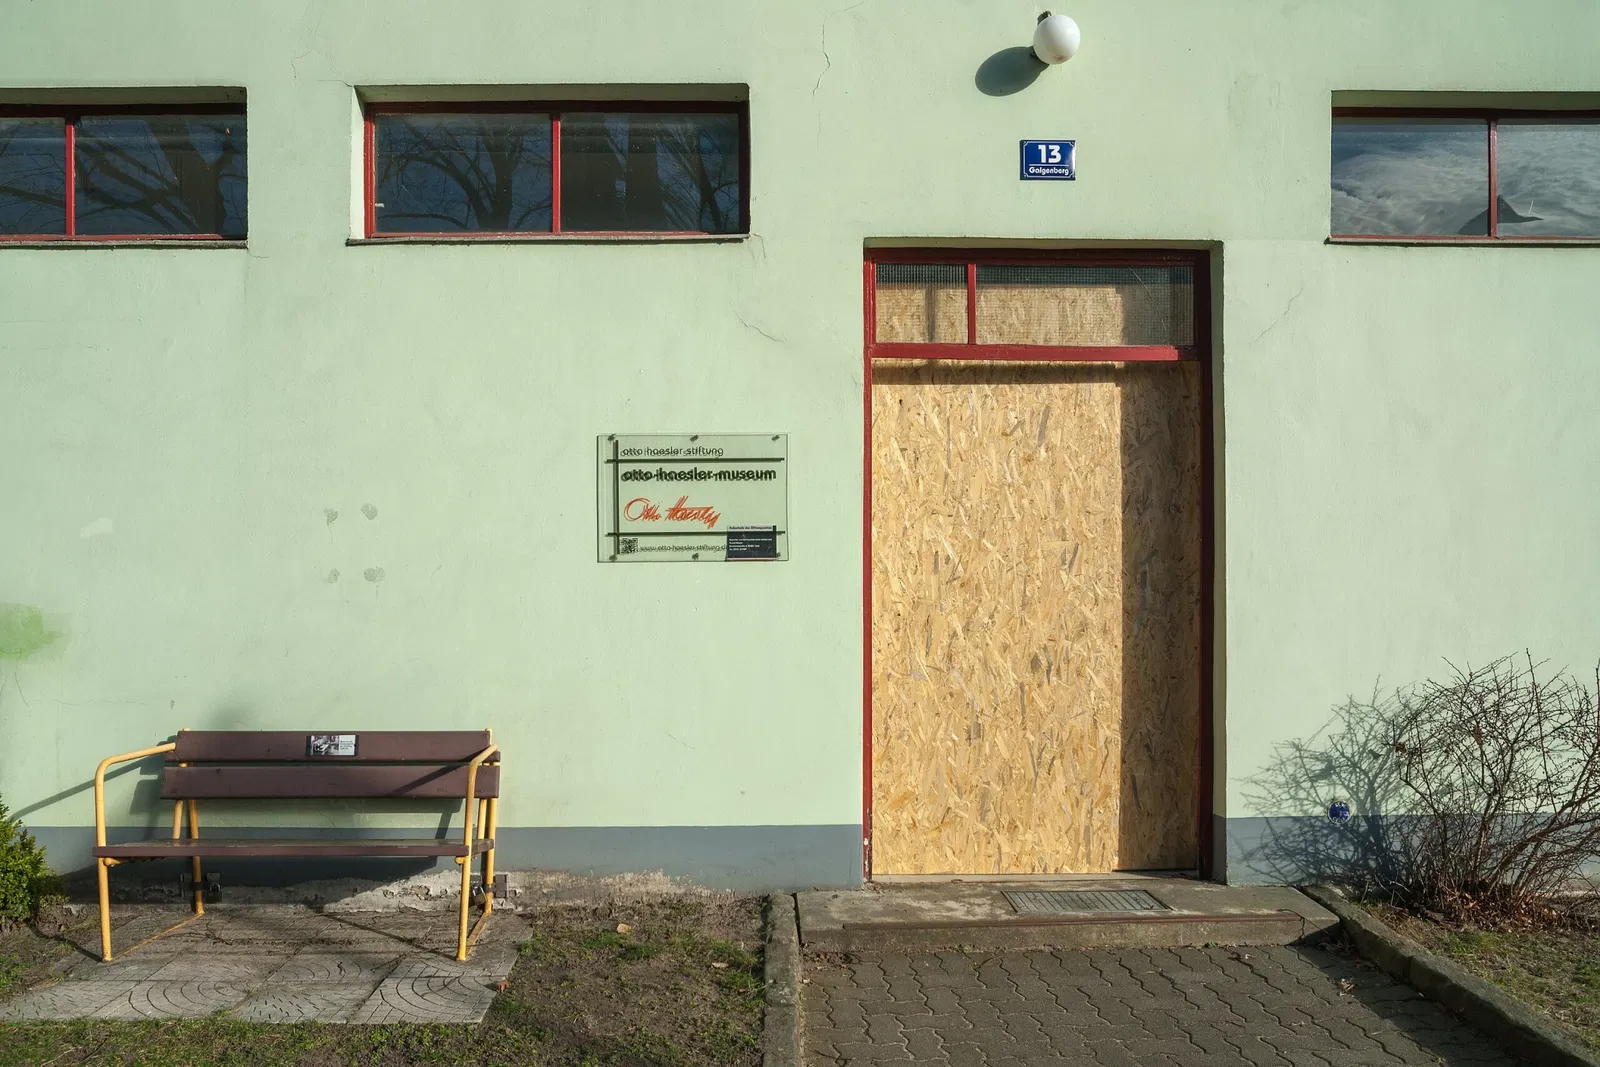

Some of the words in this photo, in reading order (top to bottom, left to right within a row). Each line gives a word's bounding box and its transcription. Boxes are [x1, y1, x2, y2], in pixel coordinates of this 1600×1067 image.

[1038, 144, 1062, 163] 13
[1029, 166, 1069, 176] Galgenberg
[621, 447, 643, 457] otto
[646, 446, 683, 457] haesler
[687, 446, 724, 459] stiftung
[640, 544, 726, 553] www.otto-haesler-stiftung.d
